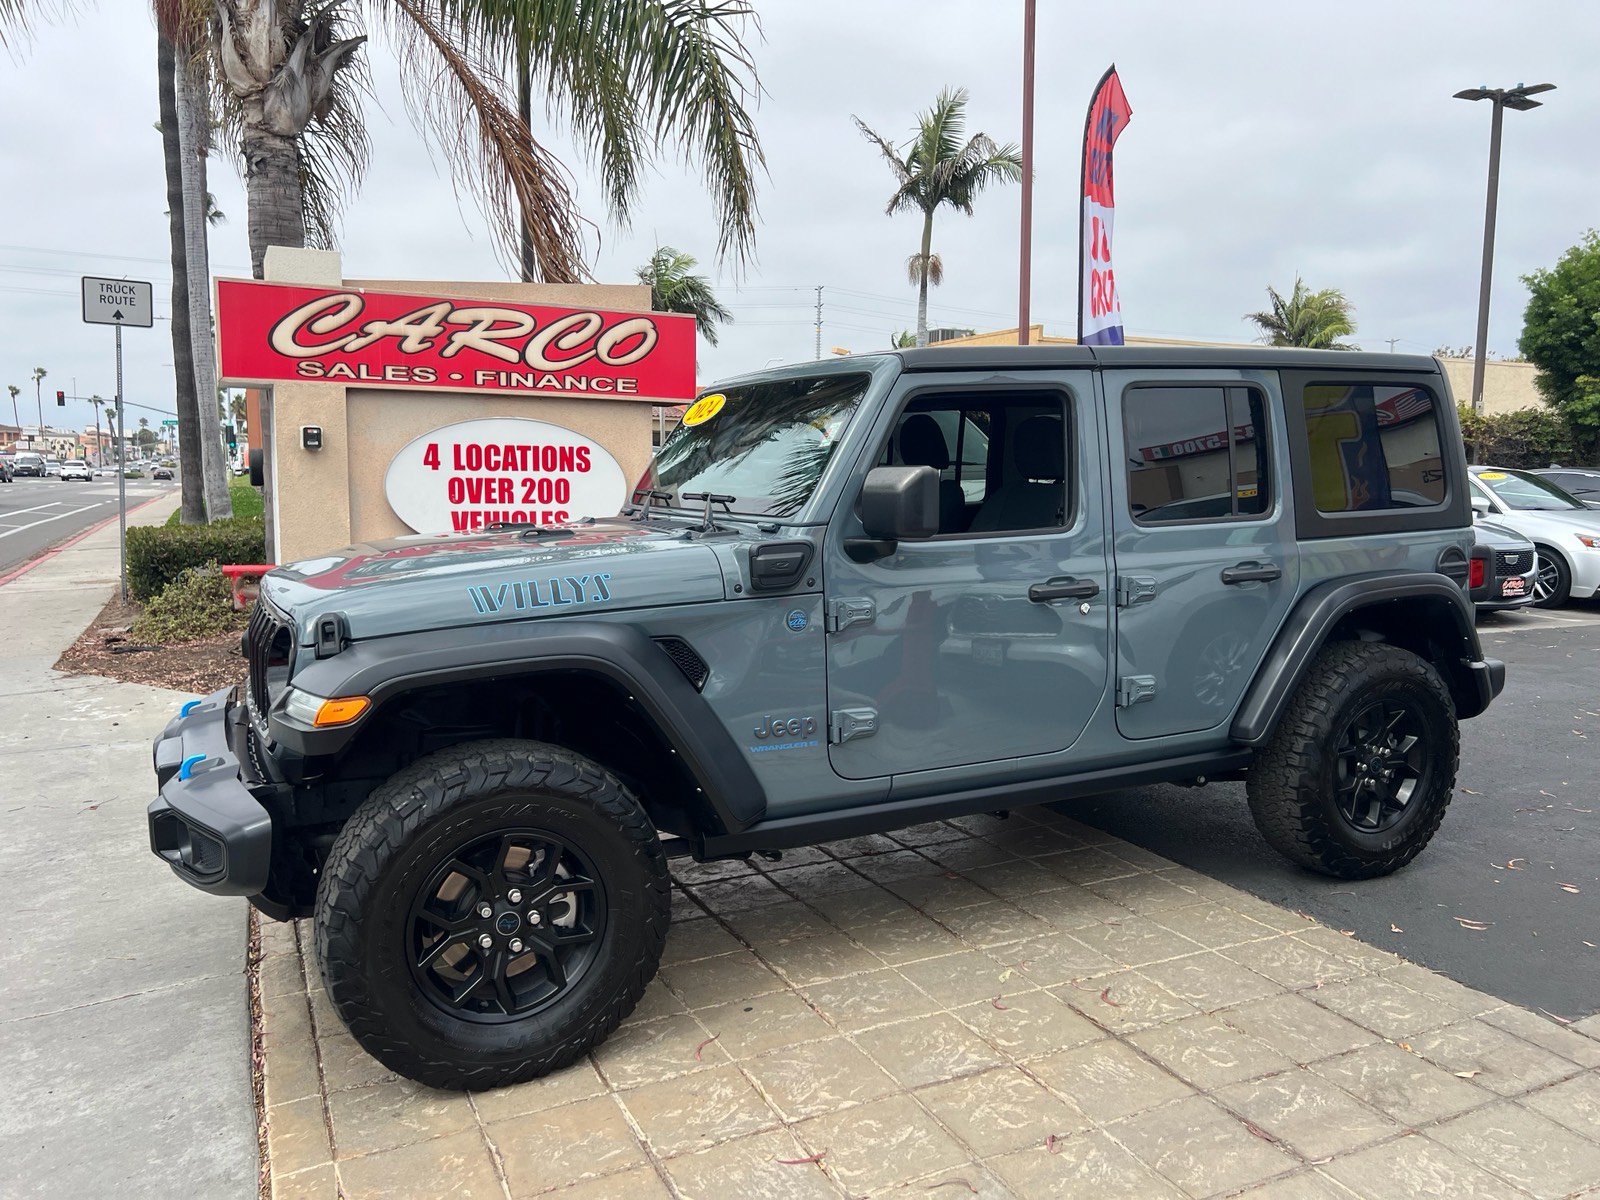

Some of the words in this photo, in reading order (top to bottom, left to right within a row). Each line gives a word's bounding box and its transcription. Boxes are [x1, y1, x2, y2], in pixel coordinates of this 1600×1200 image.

[99, 283, 136, 295] TRUCK
[99, 294, 136, 306] ROUTE
[267, 292, 659, 372] CARCO
[296, 360, 438, 383] SALES
[474, 369, 639, 393] FINANCE
[423, 443, 441, 471] 4
[453, 443, 592, 473] LOCATIONS
[448, 477, 514, 504] OVER
[520, 477, 570, 505] 200
[467, 573, 611, 613] WILLYS
[754, 714, 817, 739] Jeep
[749, 741, 808, 753] WRANGLER
